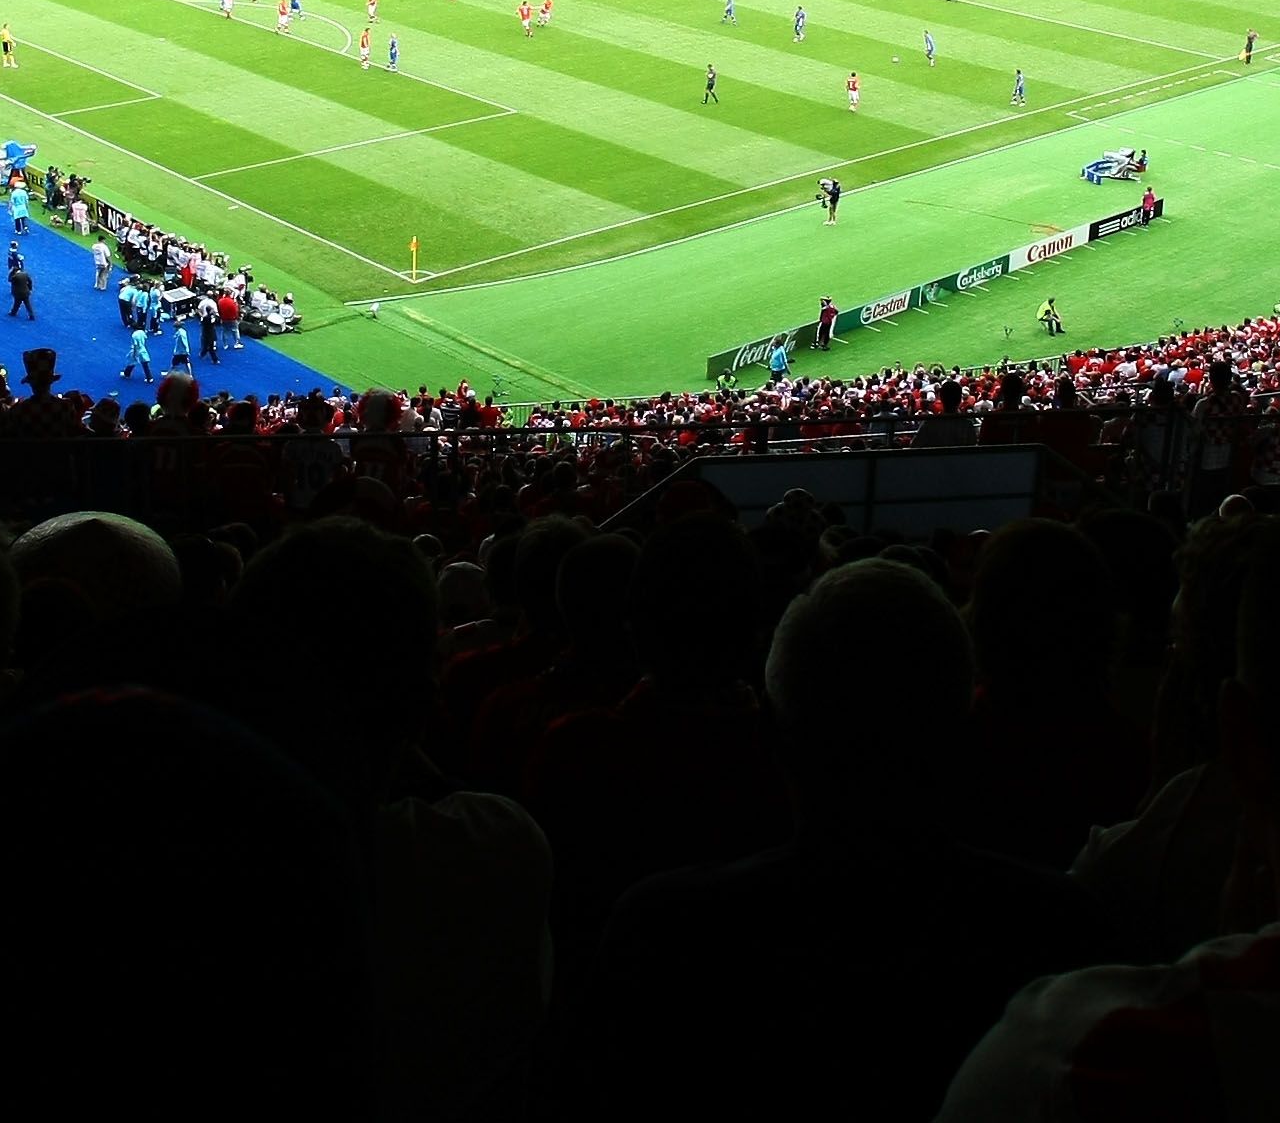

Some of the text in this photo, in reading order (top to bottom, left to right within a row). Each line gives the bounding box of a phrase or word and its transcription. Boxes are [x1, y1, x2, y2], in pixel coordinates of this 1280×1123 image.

[1027, 234, 1073, 262] Canon
[956, 261, 1004, 290] Carlsberg
[872, 293, 907, 319] Castrol
